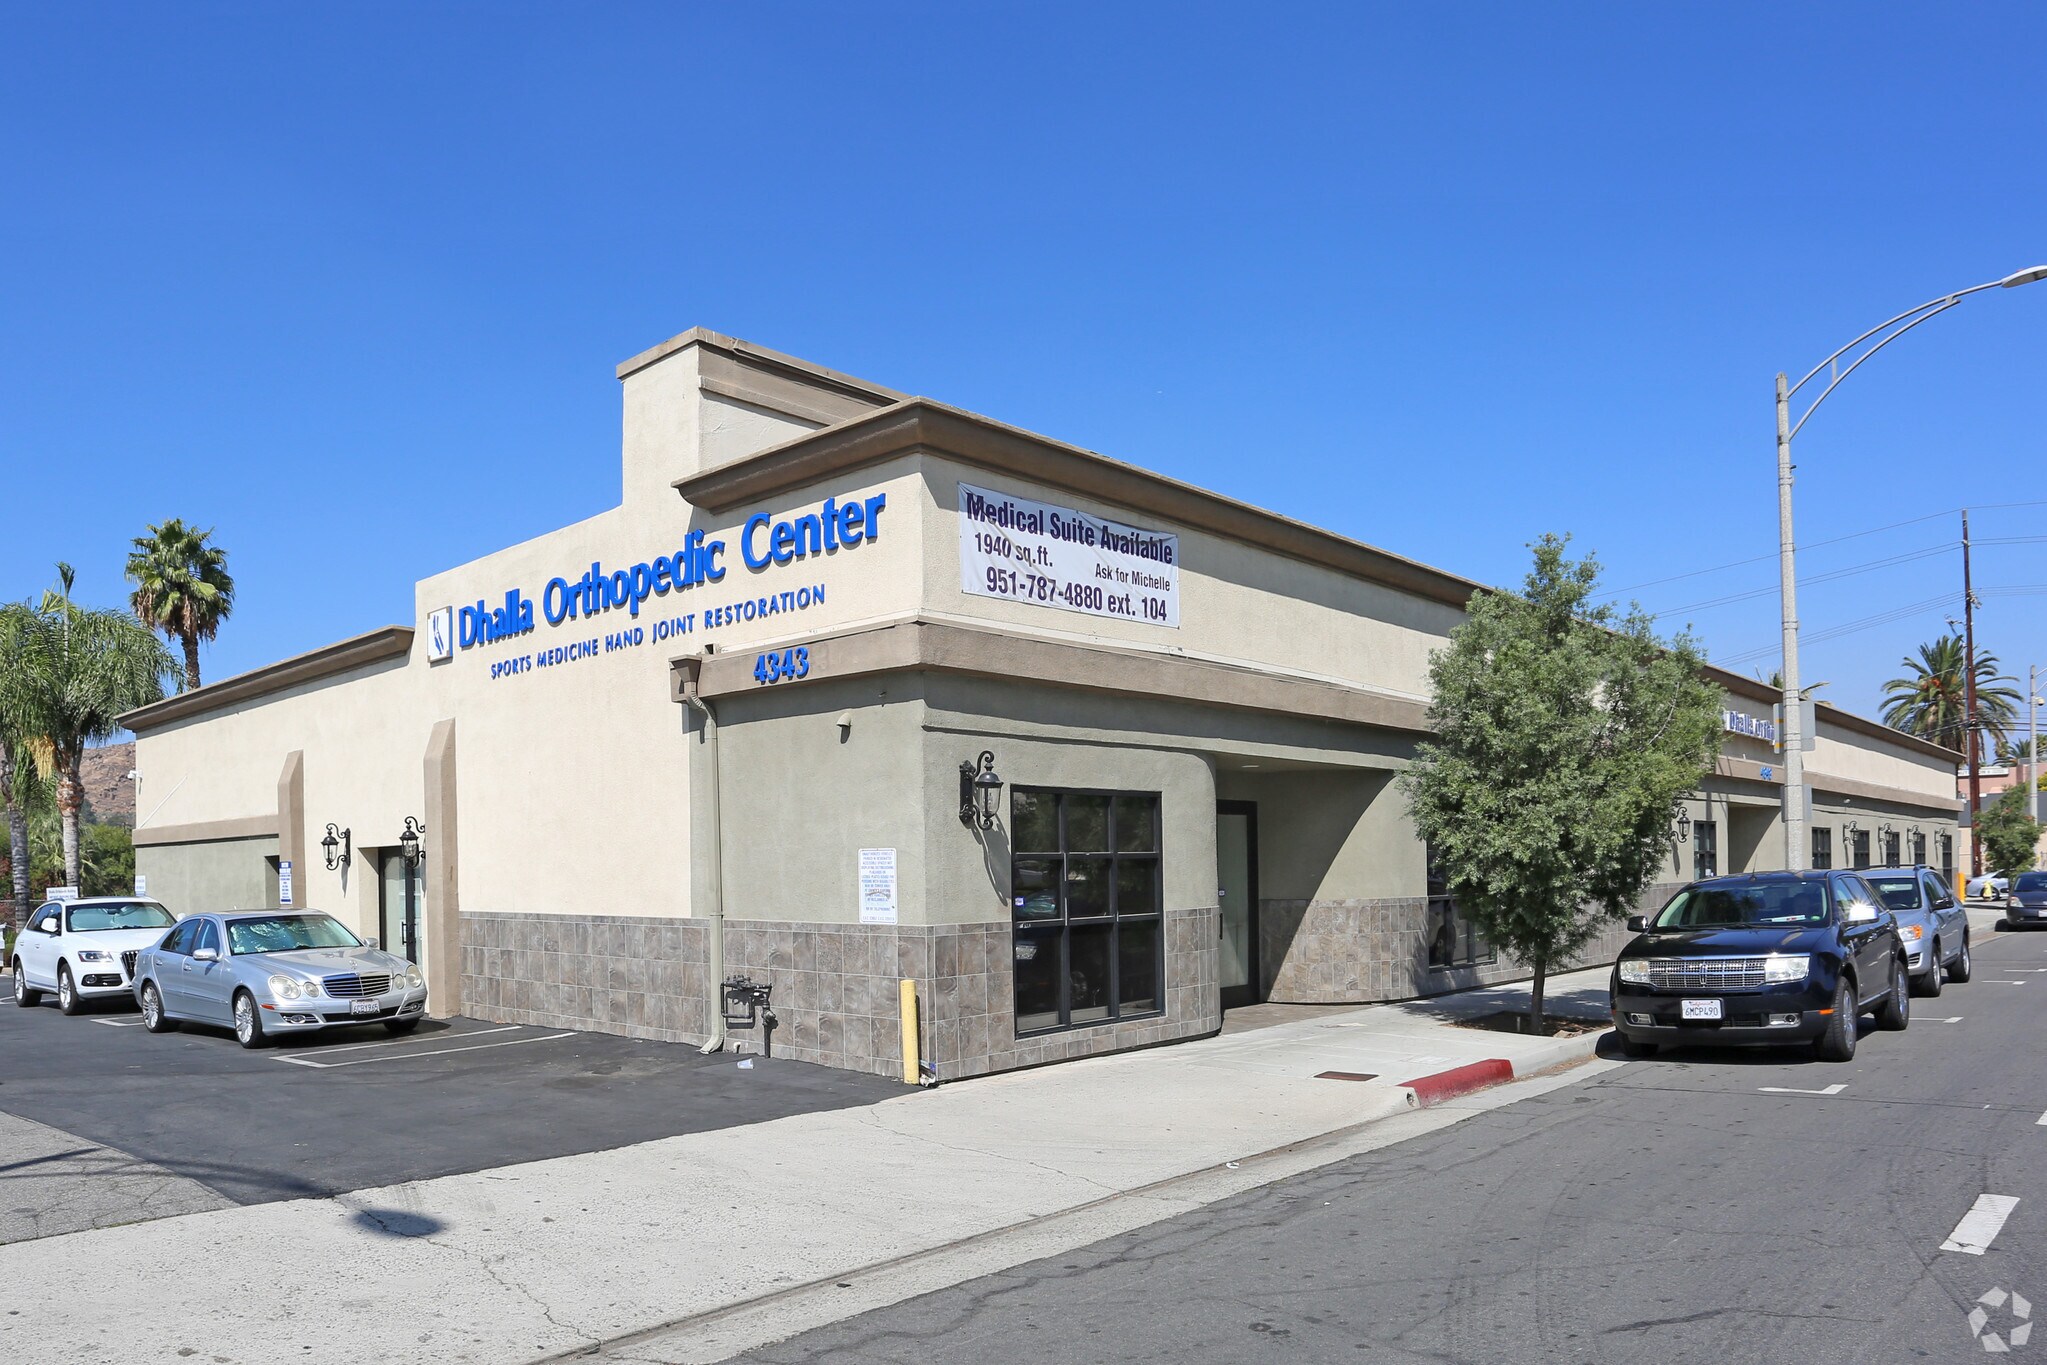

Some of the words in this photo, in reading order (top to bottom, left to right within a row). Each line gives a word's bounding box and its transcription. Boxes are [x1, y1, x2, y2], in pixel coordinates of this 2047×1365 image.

[966, 492, 1044, 536] Medical
[1050, 512, 1095, 547] Suite
[1100, 525, 1173, 565] Available
[975, 532, 1012, 559] 1940
[1015, 544, 1053, 567] sq.ft.
[459, 588, 535, 648] Dhalla
[543, 529, 726, 615] Orthopedic
[741, 493, 886, 568] Center
[1095, 563, 1113, 580] Ask
[1115, 566, 1129, 584] for
[1131, 570, 1171, 592] Michelle
[986, 566, 1103, 611] 951-787-4880
[1107, 594, 1136, 616] ext.
[1141, 596, 1167, 621] 104
[490, 653, 532, 679] SPORTS
[536, 638, 599, 667] MEDICINE
[605, 627, 644, 653] HAND
[652, 613, 695, 645] JOINT
[704, 583, 826, 629] RESTORATION
[753, 647, 811, 683] 4343
[1685, 1006, 1719, 1016] 6MCP490
